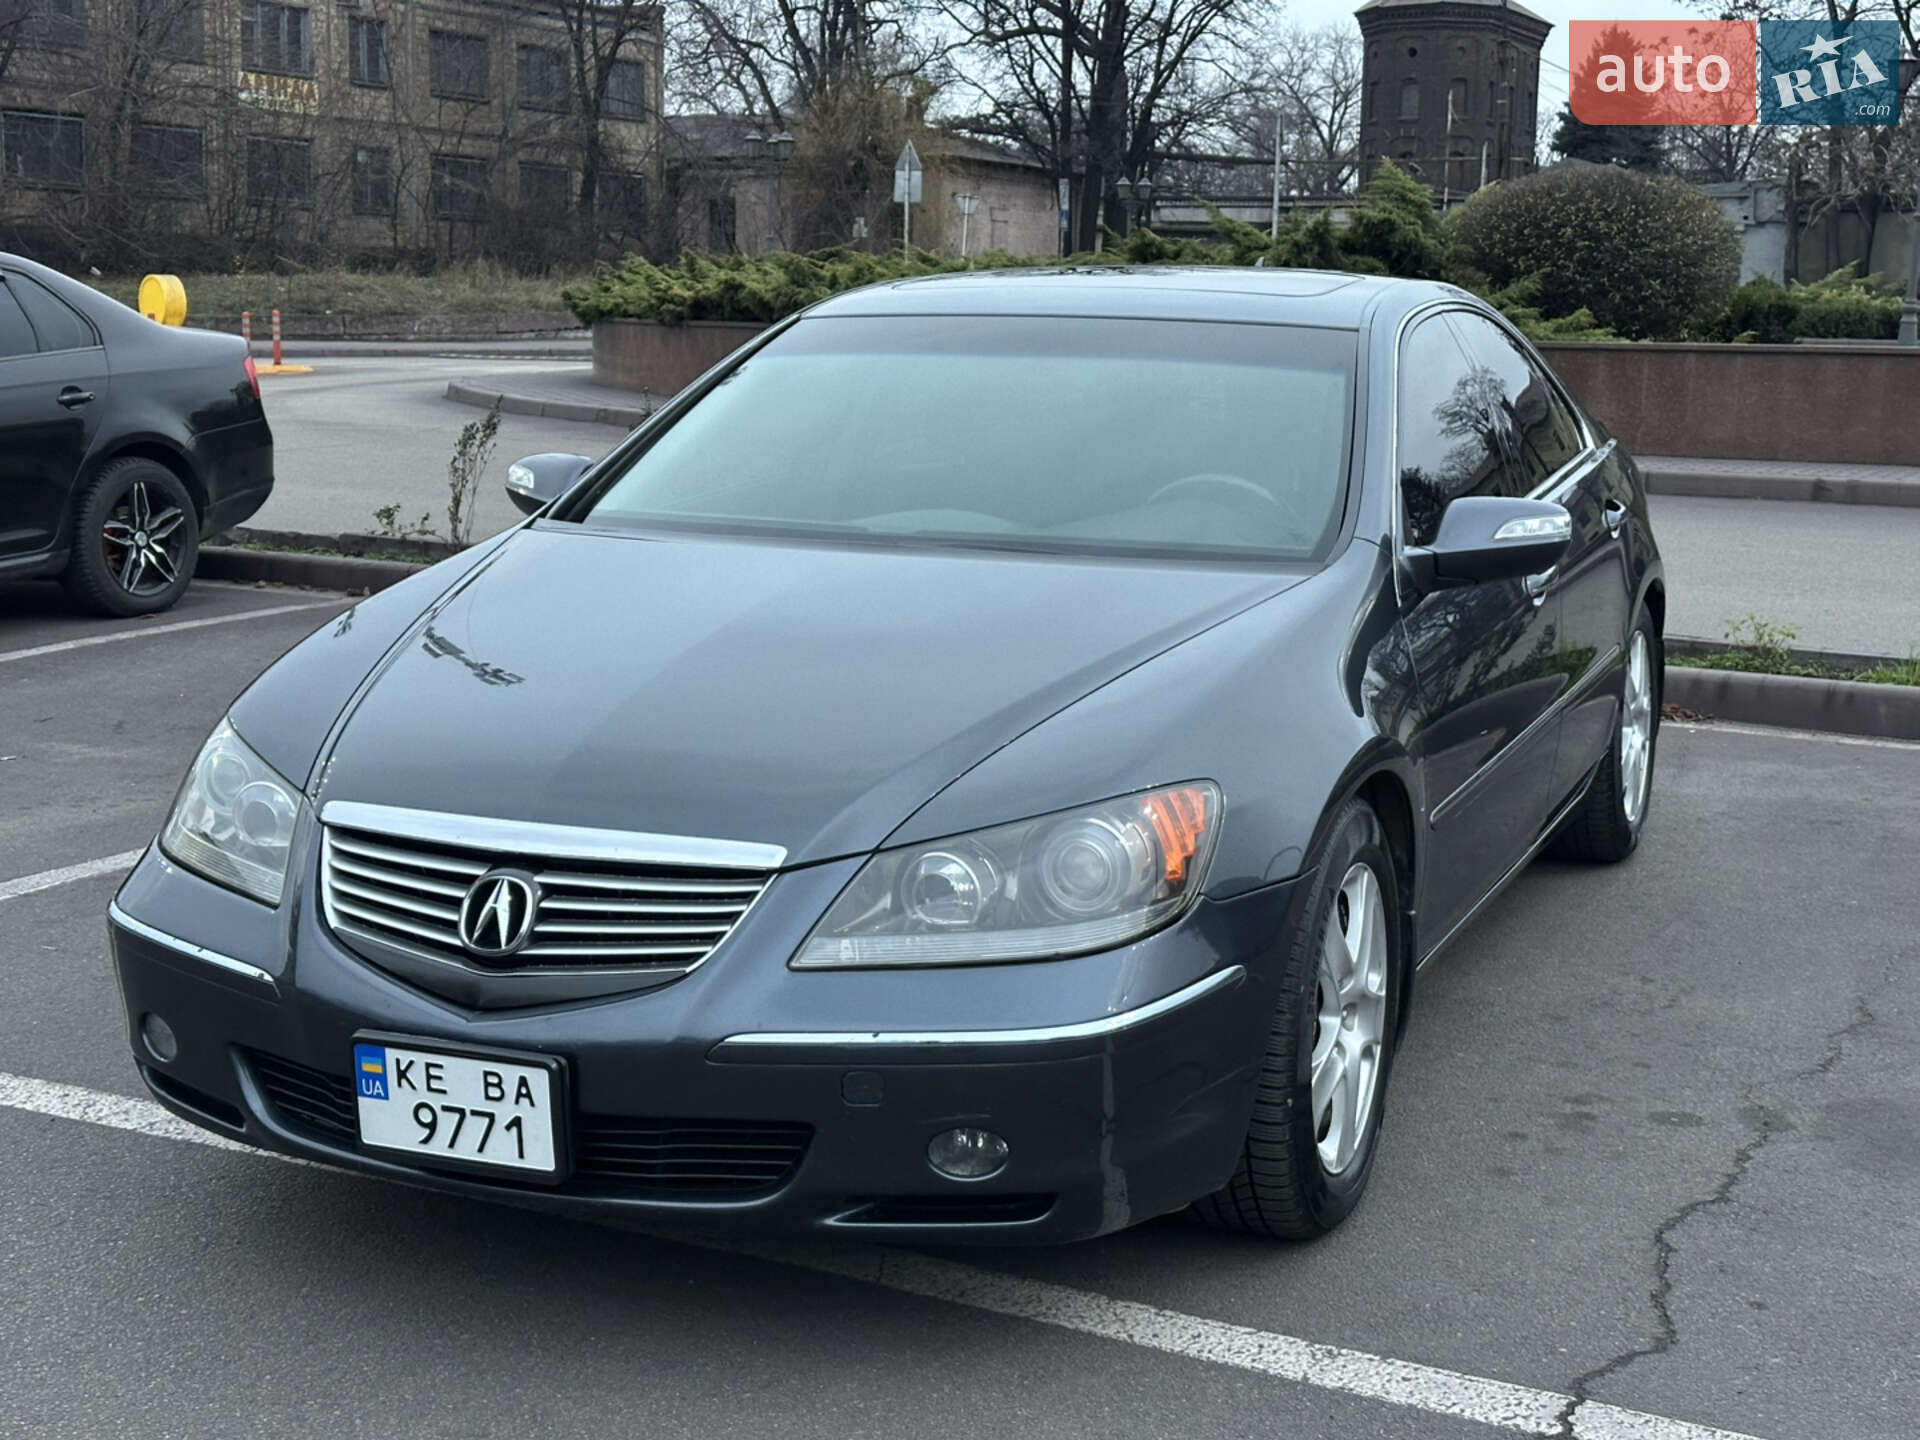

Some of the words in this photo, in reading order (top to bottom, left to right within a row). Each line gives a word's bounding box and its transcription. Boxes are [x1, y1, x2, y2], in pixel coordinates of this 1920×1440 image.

[361, 1079, 385, 1097] UA
[395, 1057, 448, 1095] KE
[482, 1069, 536, 1108] BA
[412, 1101, 525, 1159] 9771
